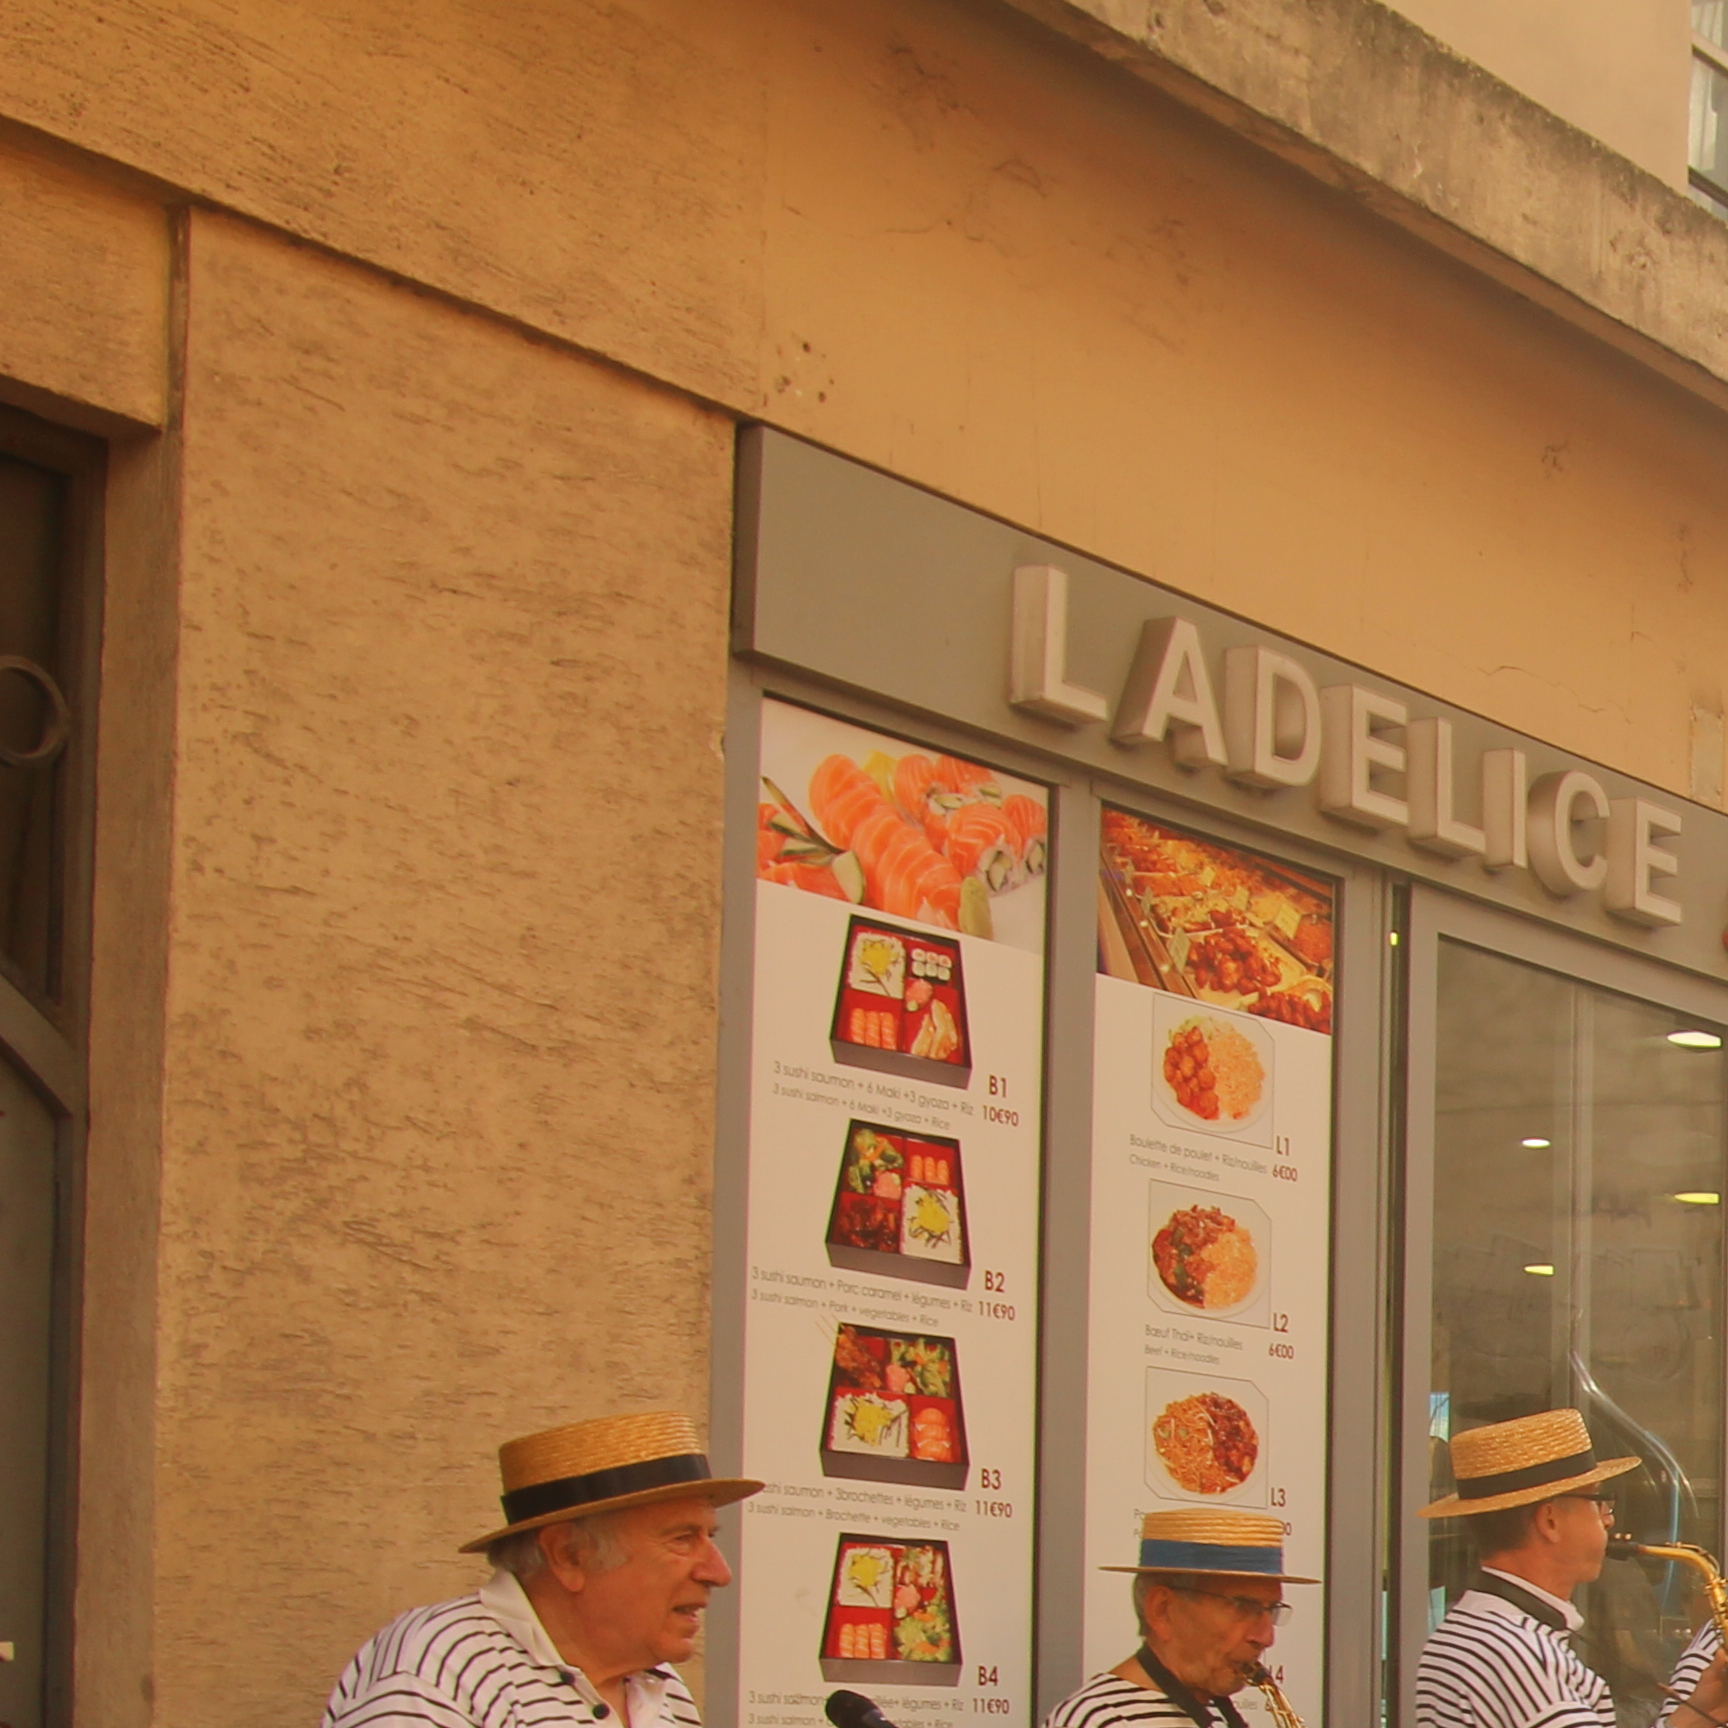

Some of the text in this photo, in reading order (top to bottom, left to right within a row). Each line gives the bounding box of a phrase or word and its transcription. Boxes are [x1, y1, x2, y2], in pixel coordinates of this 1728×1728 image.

[1011, 563, 1682, 928] LADELICE
[774, 1061, 781, 1074] 3
[784, 1064, 809, 1081] sushi
[811, 1071, 855, 1090] saumon
[867, 1081, 874, 1094] 6
[876, 1083, 901, 1099] Maki
[989, 1075, 1008, 1098] B1
[982, 1104, 1019, 1127] 10€90
[1276, 1136, 1290, 1156] L1
[1272, 1164, 1298, 1182] 6€00
[752, 1267, 760, 1280] 3
[761, 1270, 785, 1285] sushi
[786, 1273, 827, 1290] saumon
[984, 1270, 1006, 1292] B2
[978, 1301, 1015, 1321] 11€90
[1273, 1313, 1289, 1333] L2
[1269, 1344, 1294, 1360] 6€00
[981, 1469, 1001, 1490] B3
[1271, 1487, 1286, 1507] L3
[975, 1500, 1013, 1518] 11€90
[978, 1666, 999, 1687] B4
[973, 1698, 1010, 1715] 11€90
